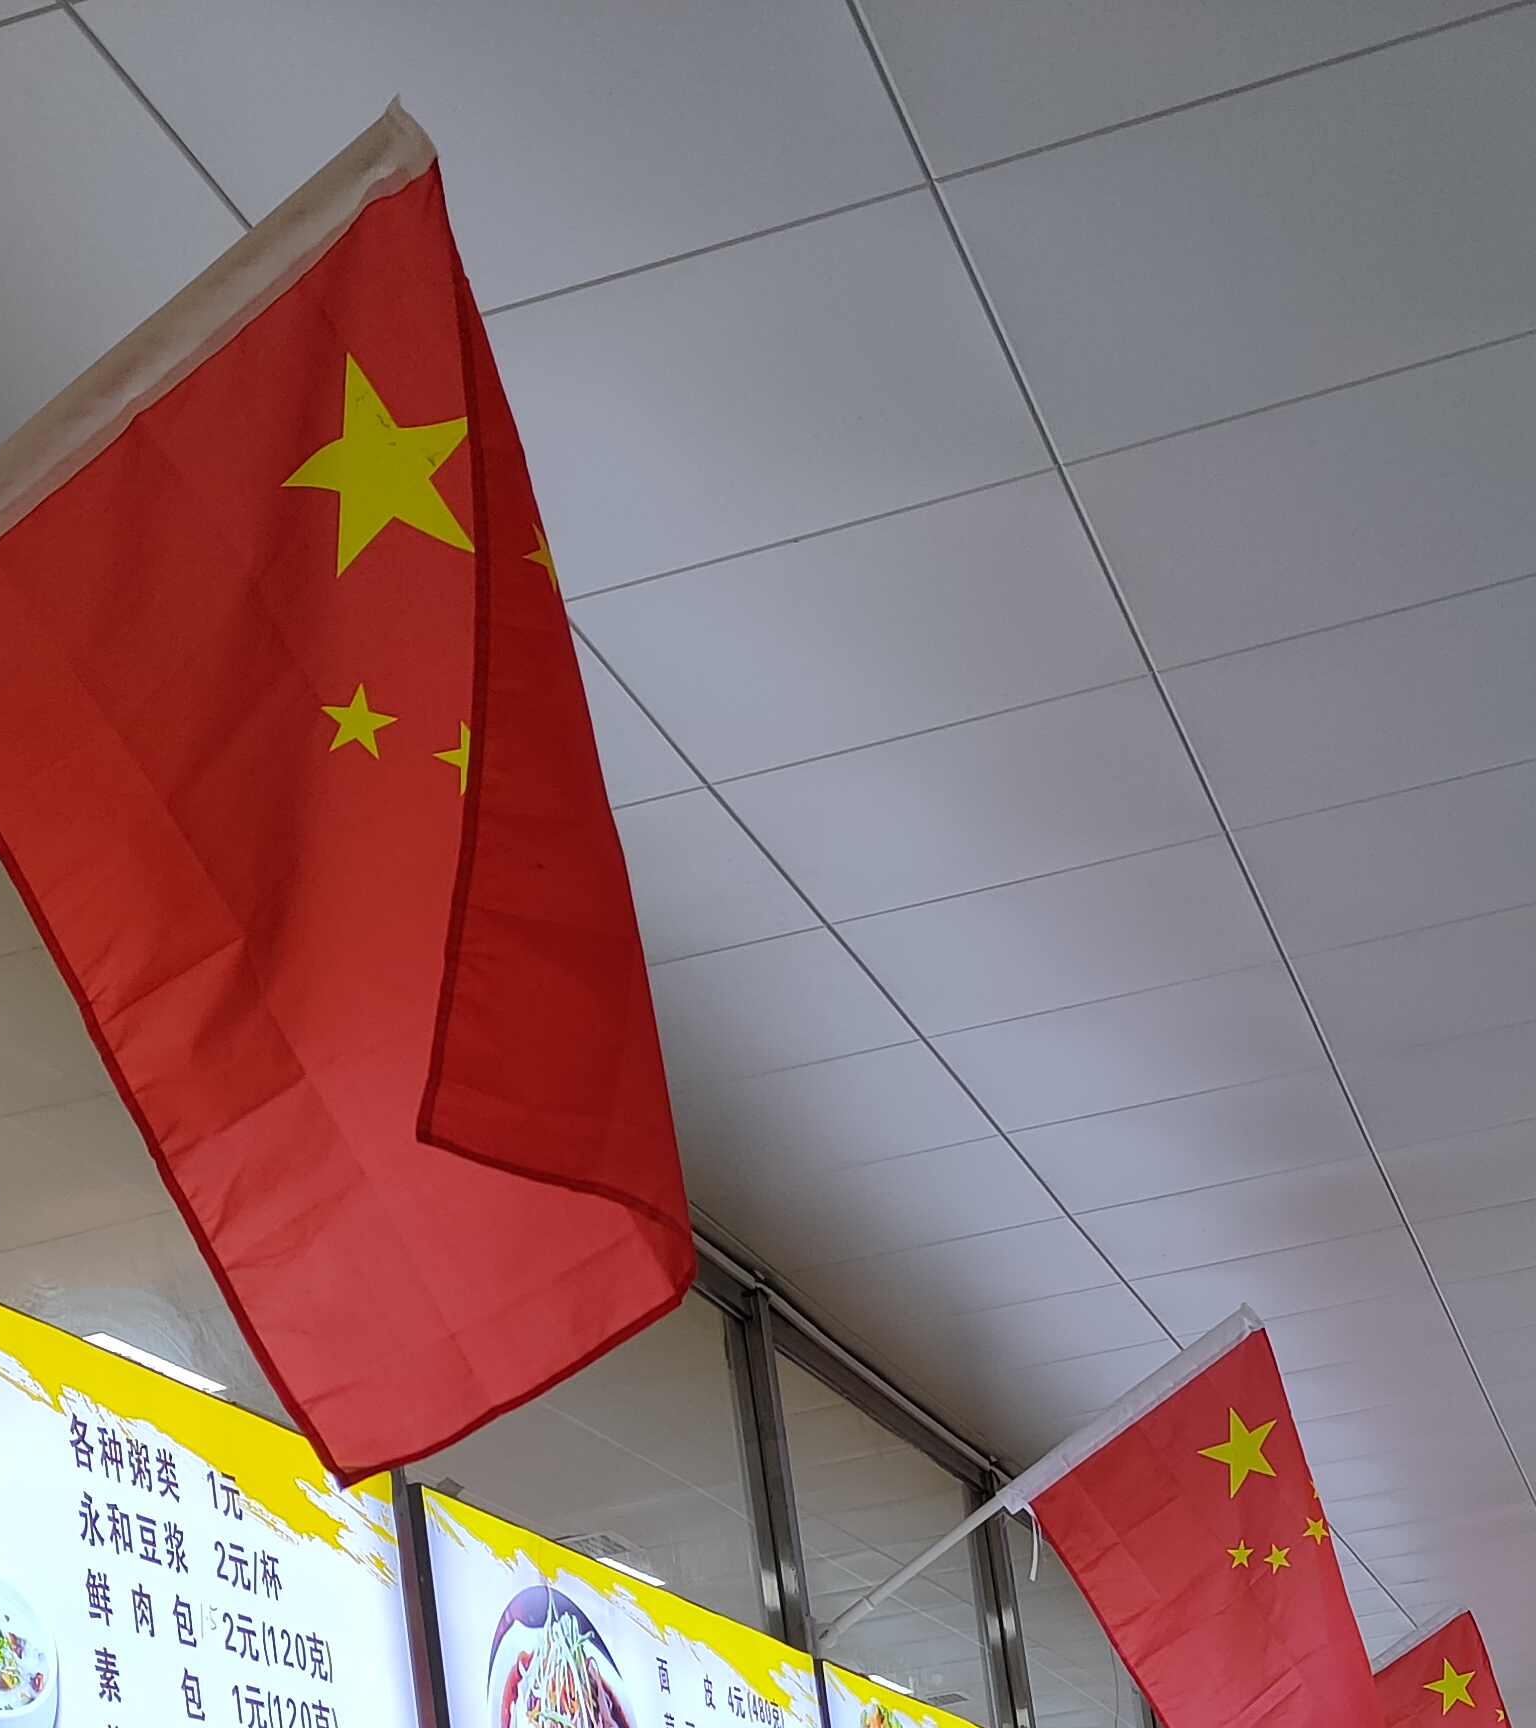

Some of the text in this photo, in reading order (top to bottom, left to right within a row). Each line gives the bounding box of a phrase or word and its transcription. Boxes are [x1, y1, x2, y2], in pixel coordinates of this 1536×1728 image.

[69, 1413, 244, 1520] 各种粥类 1元
[78, 1491, 283, 1601] 永和豆浆 2元/杯
[85, 1568, 333, 1684] 鲜肉包 2元(120克)
